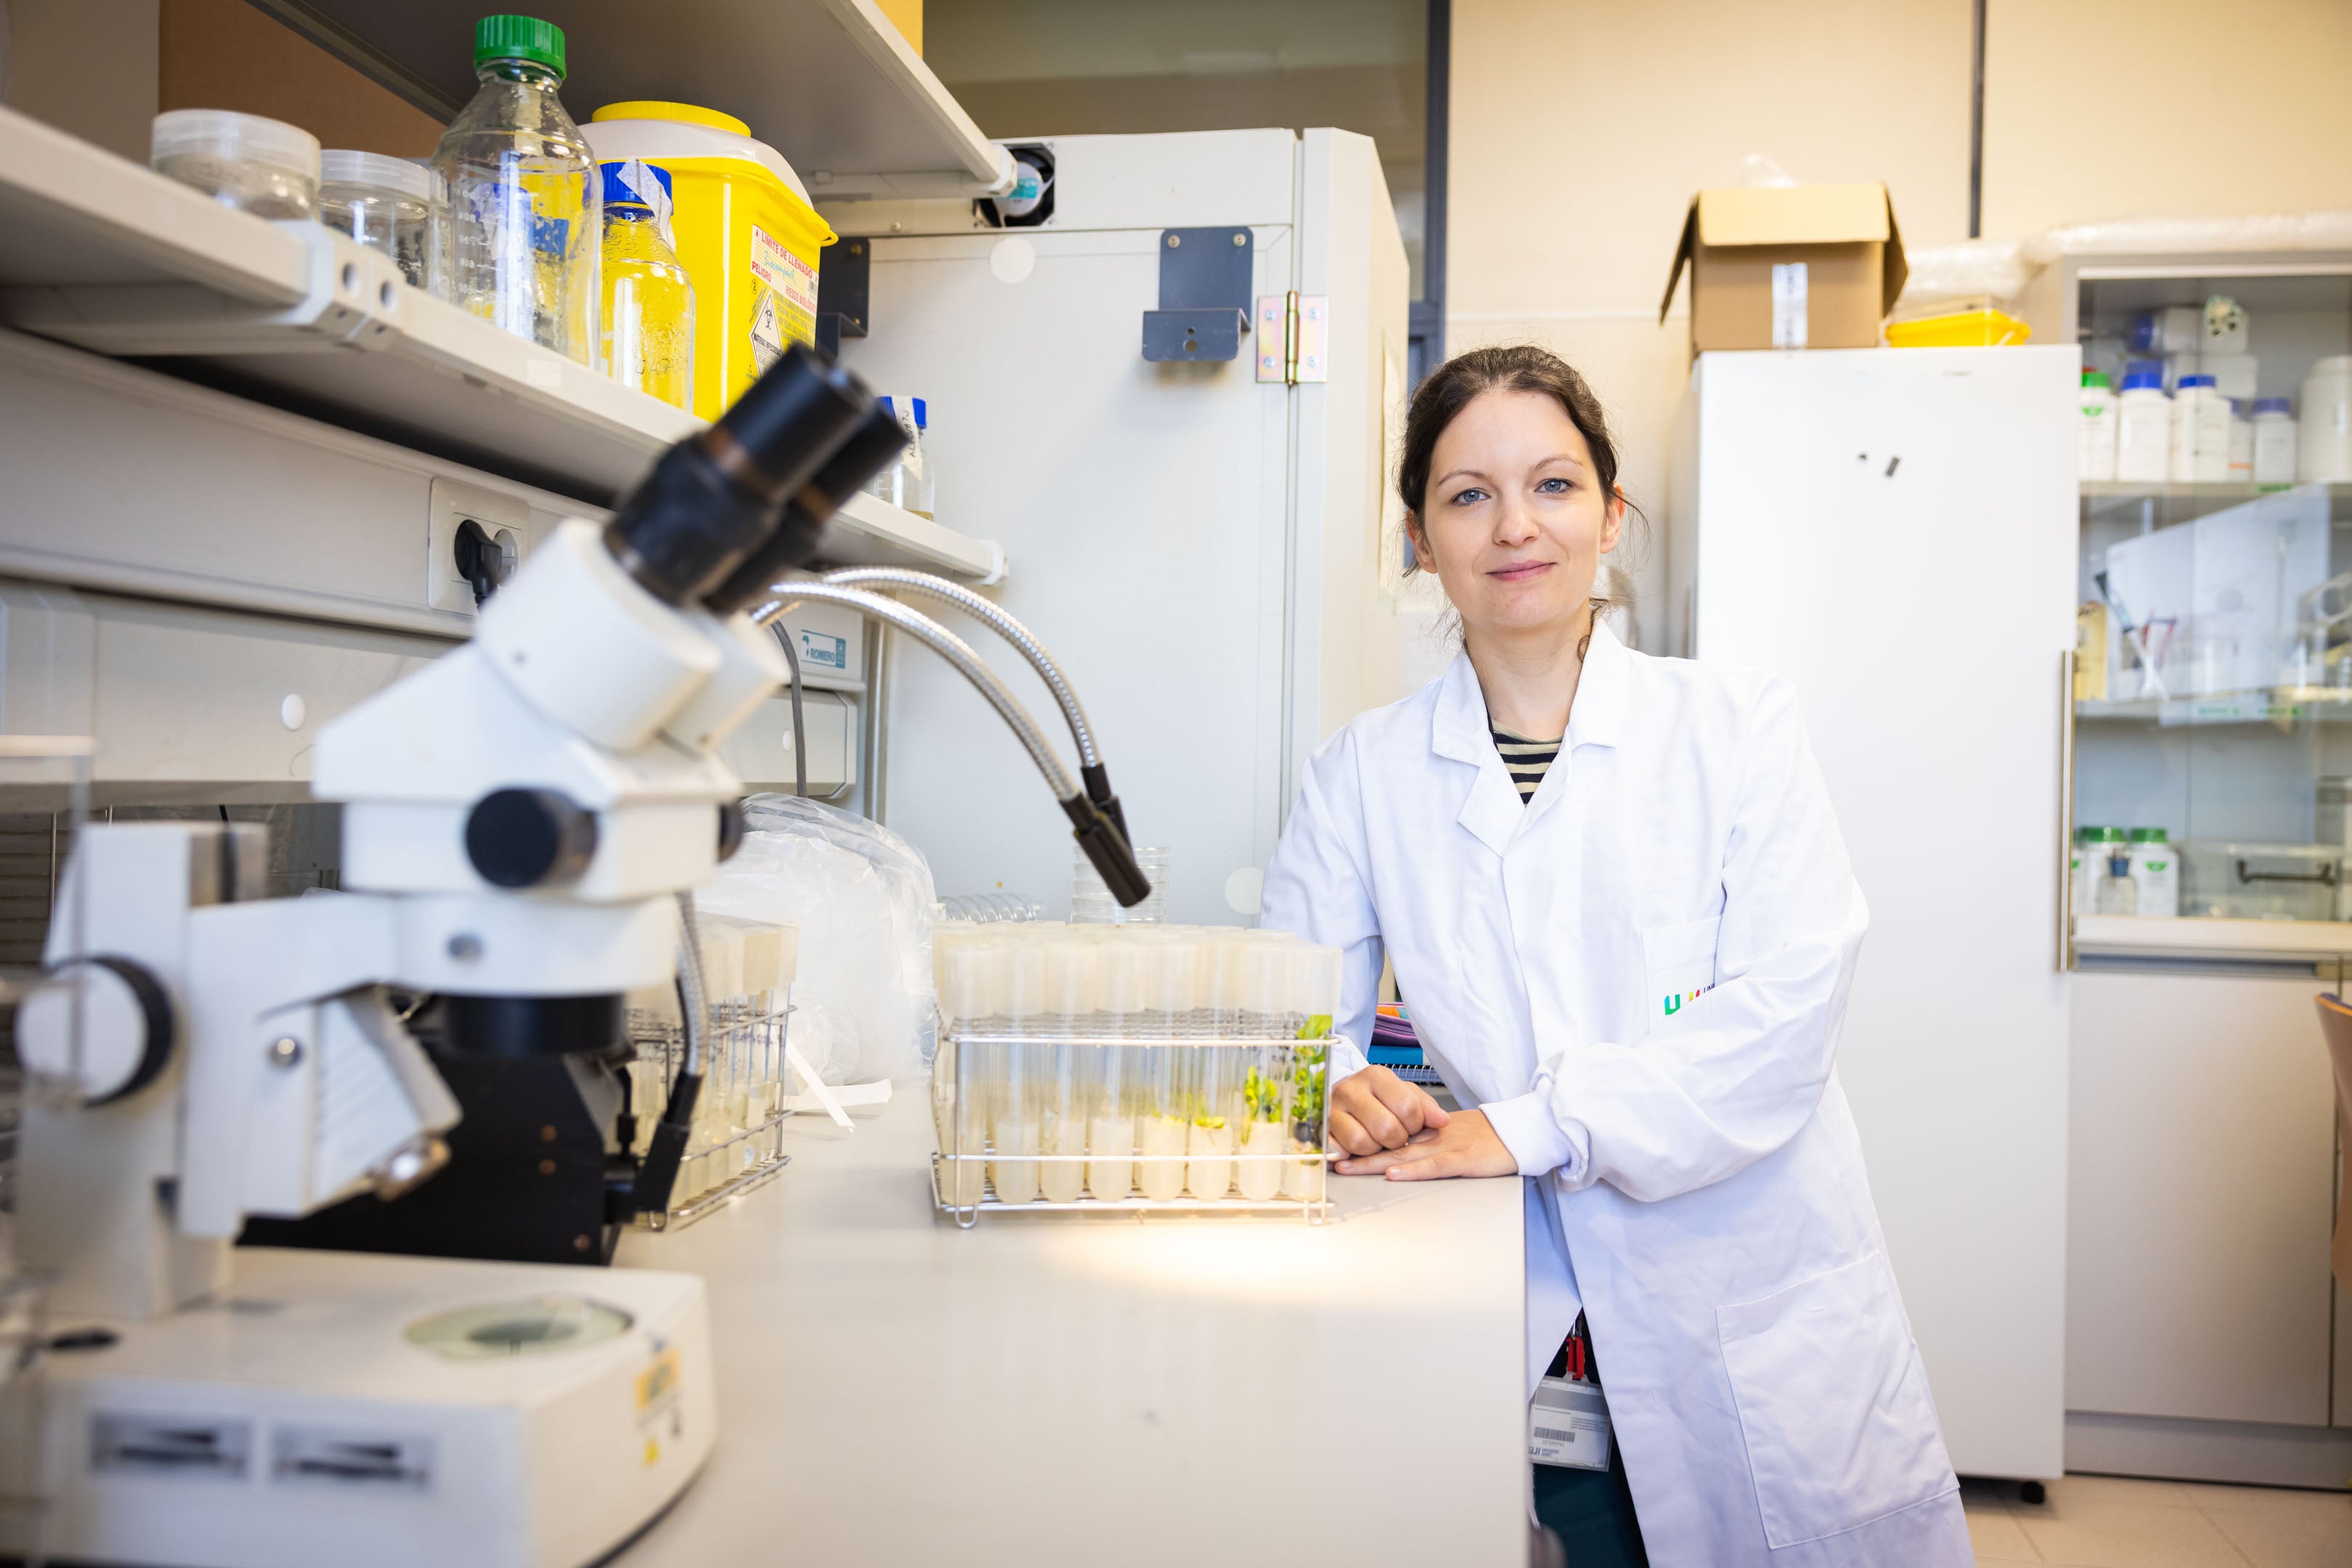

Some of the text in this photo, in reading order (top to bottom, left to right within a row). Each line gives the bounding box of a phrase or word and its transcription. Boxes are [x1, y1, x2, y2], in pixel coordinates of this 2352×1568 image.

[752, 261, 772, 282] PELIGRO
[780, 247, 787, 261] DE
[788, 253, 813, 279] LLENADO
